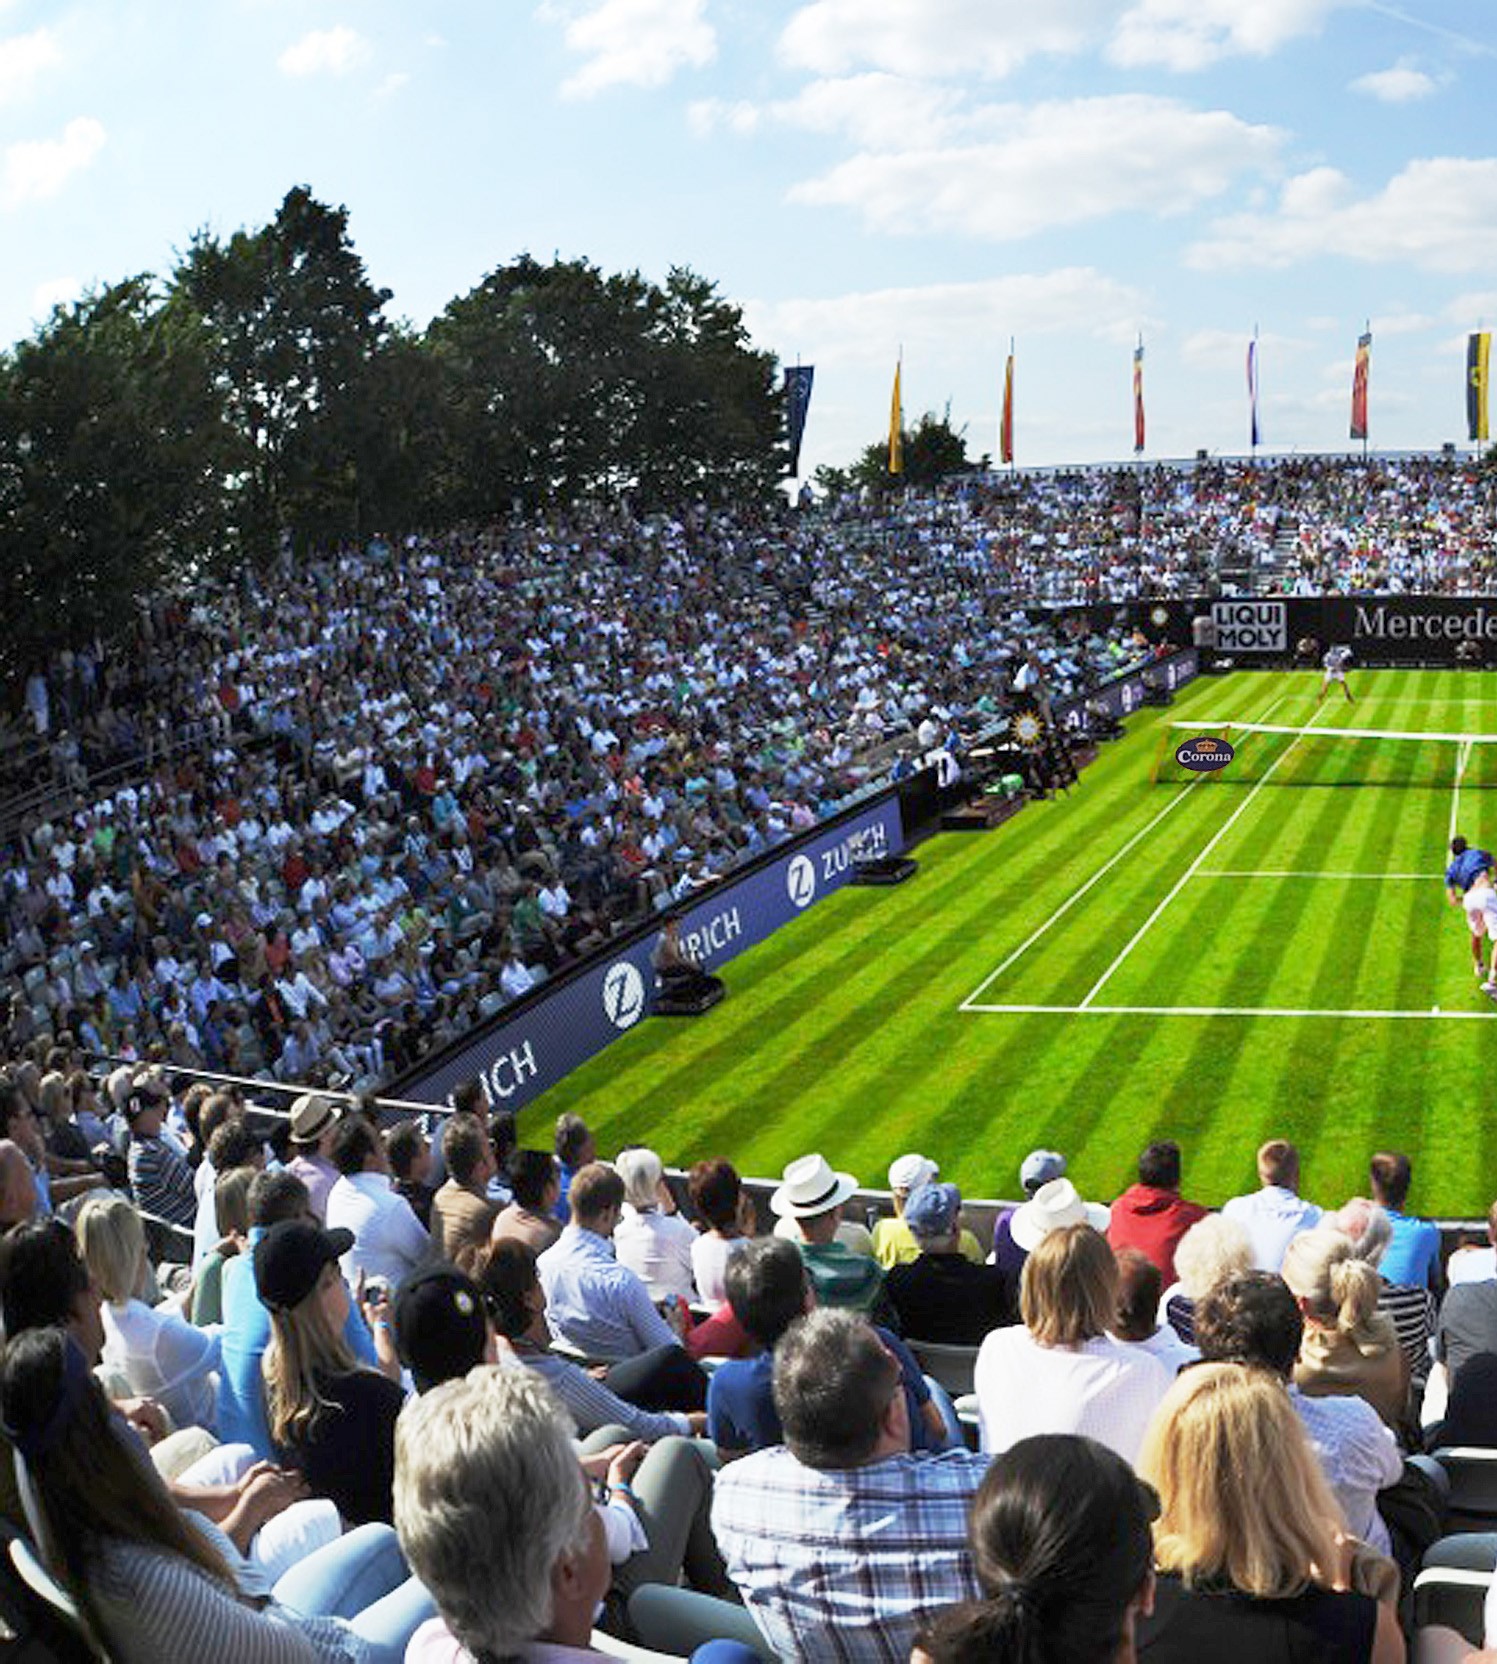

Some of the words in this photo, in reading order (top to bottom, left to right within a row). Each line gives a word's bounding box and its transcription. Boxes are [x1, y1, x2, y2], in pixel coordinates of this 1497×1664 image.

[1216, 605, 1281, 626] LIQUI
[1217, 628, 1281, 648] MOLY
[1177, 749, 1231, 763] Corona
